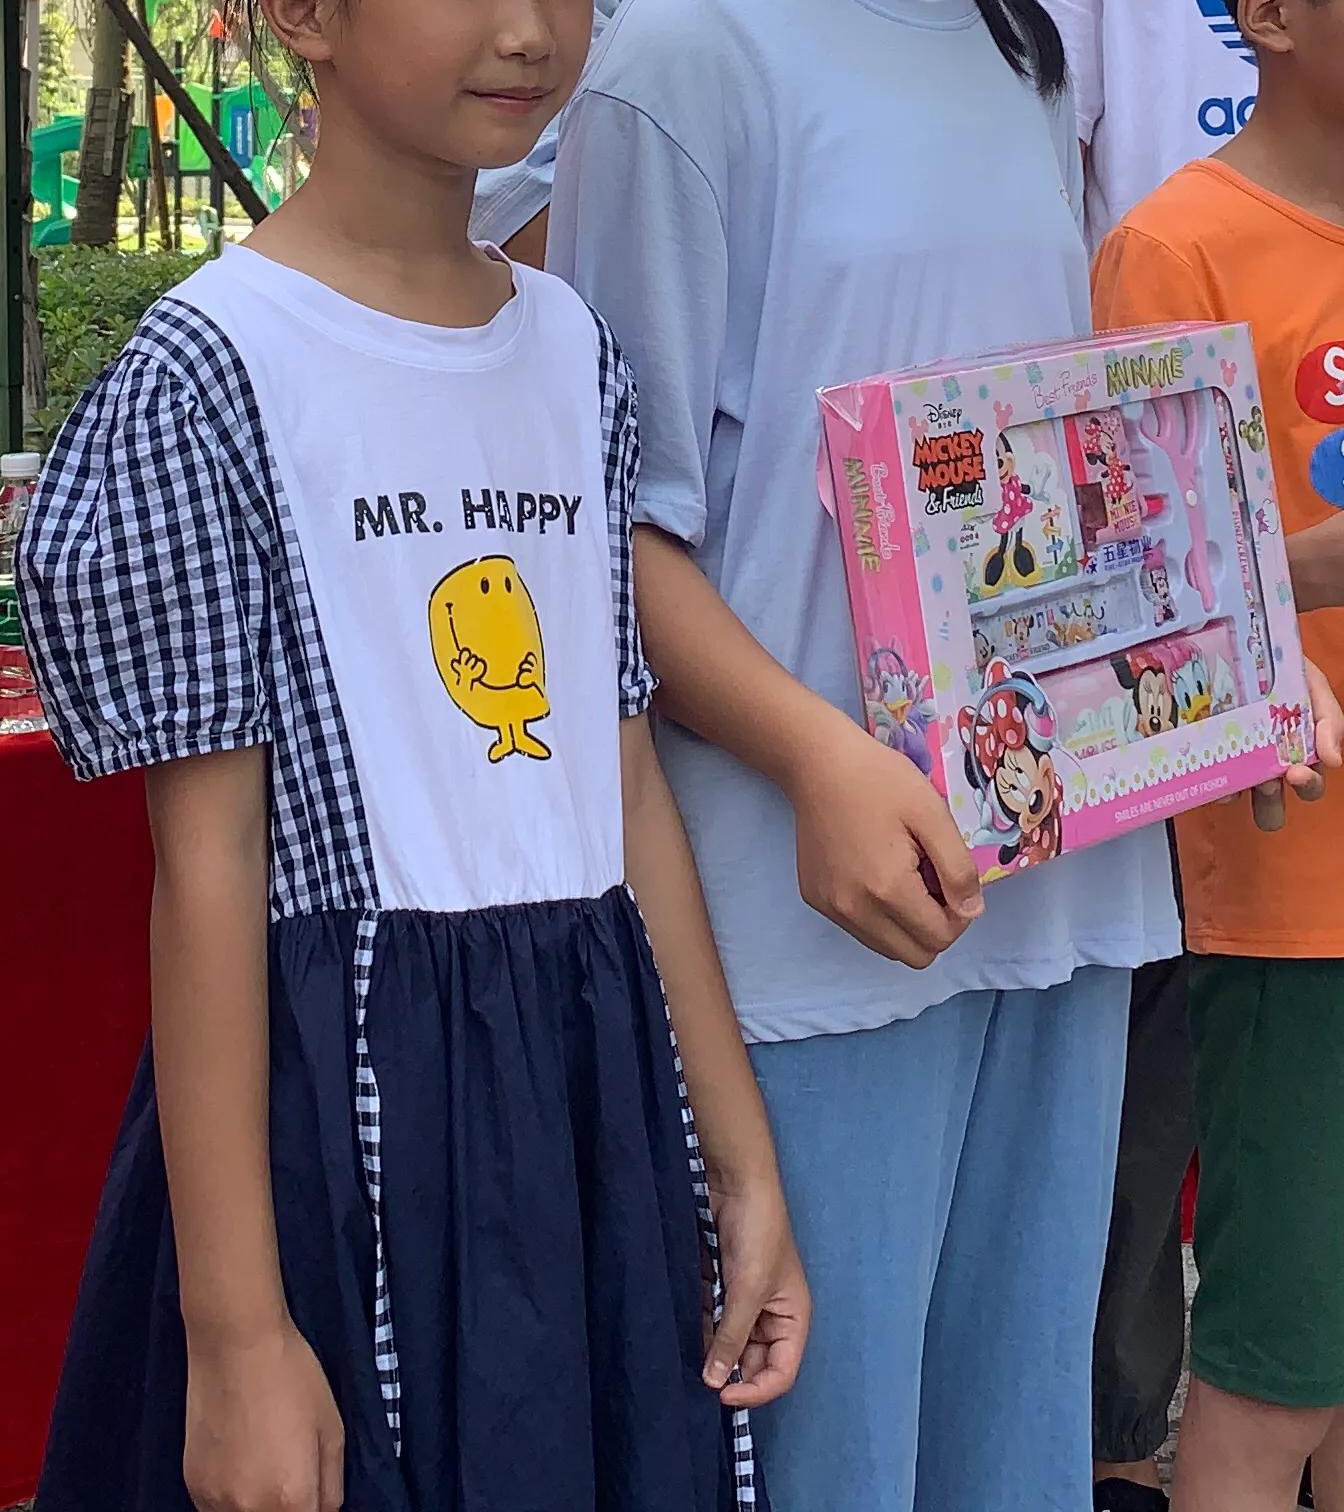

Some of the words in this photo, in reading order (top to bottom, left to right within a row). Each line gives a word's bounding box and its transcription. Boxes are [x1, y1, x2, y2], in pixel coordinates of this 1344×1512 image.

[1106, 347, 1185, 398] MINNIE
[913, 428, 984, 467] MICKEY
[918, 455, 987, 492] MOUSE
[353, 491, 443, 542] MR.
[460, 488, 583, 535] HAPPY
